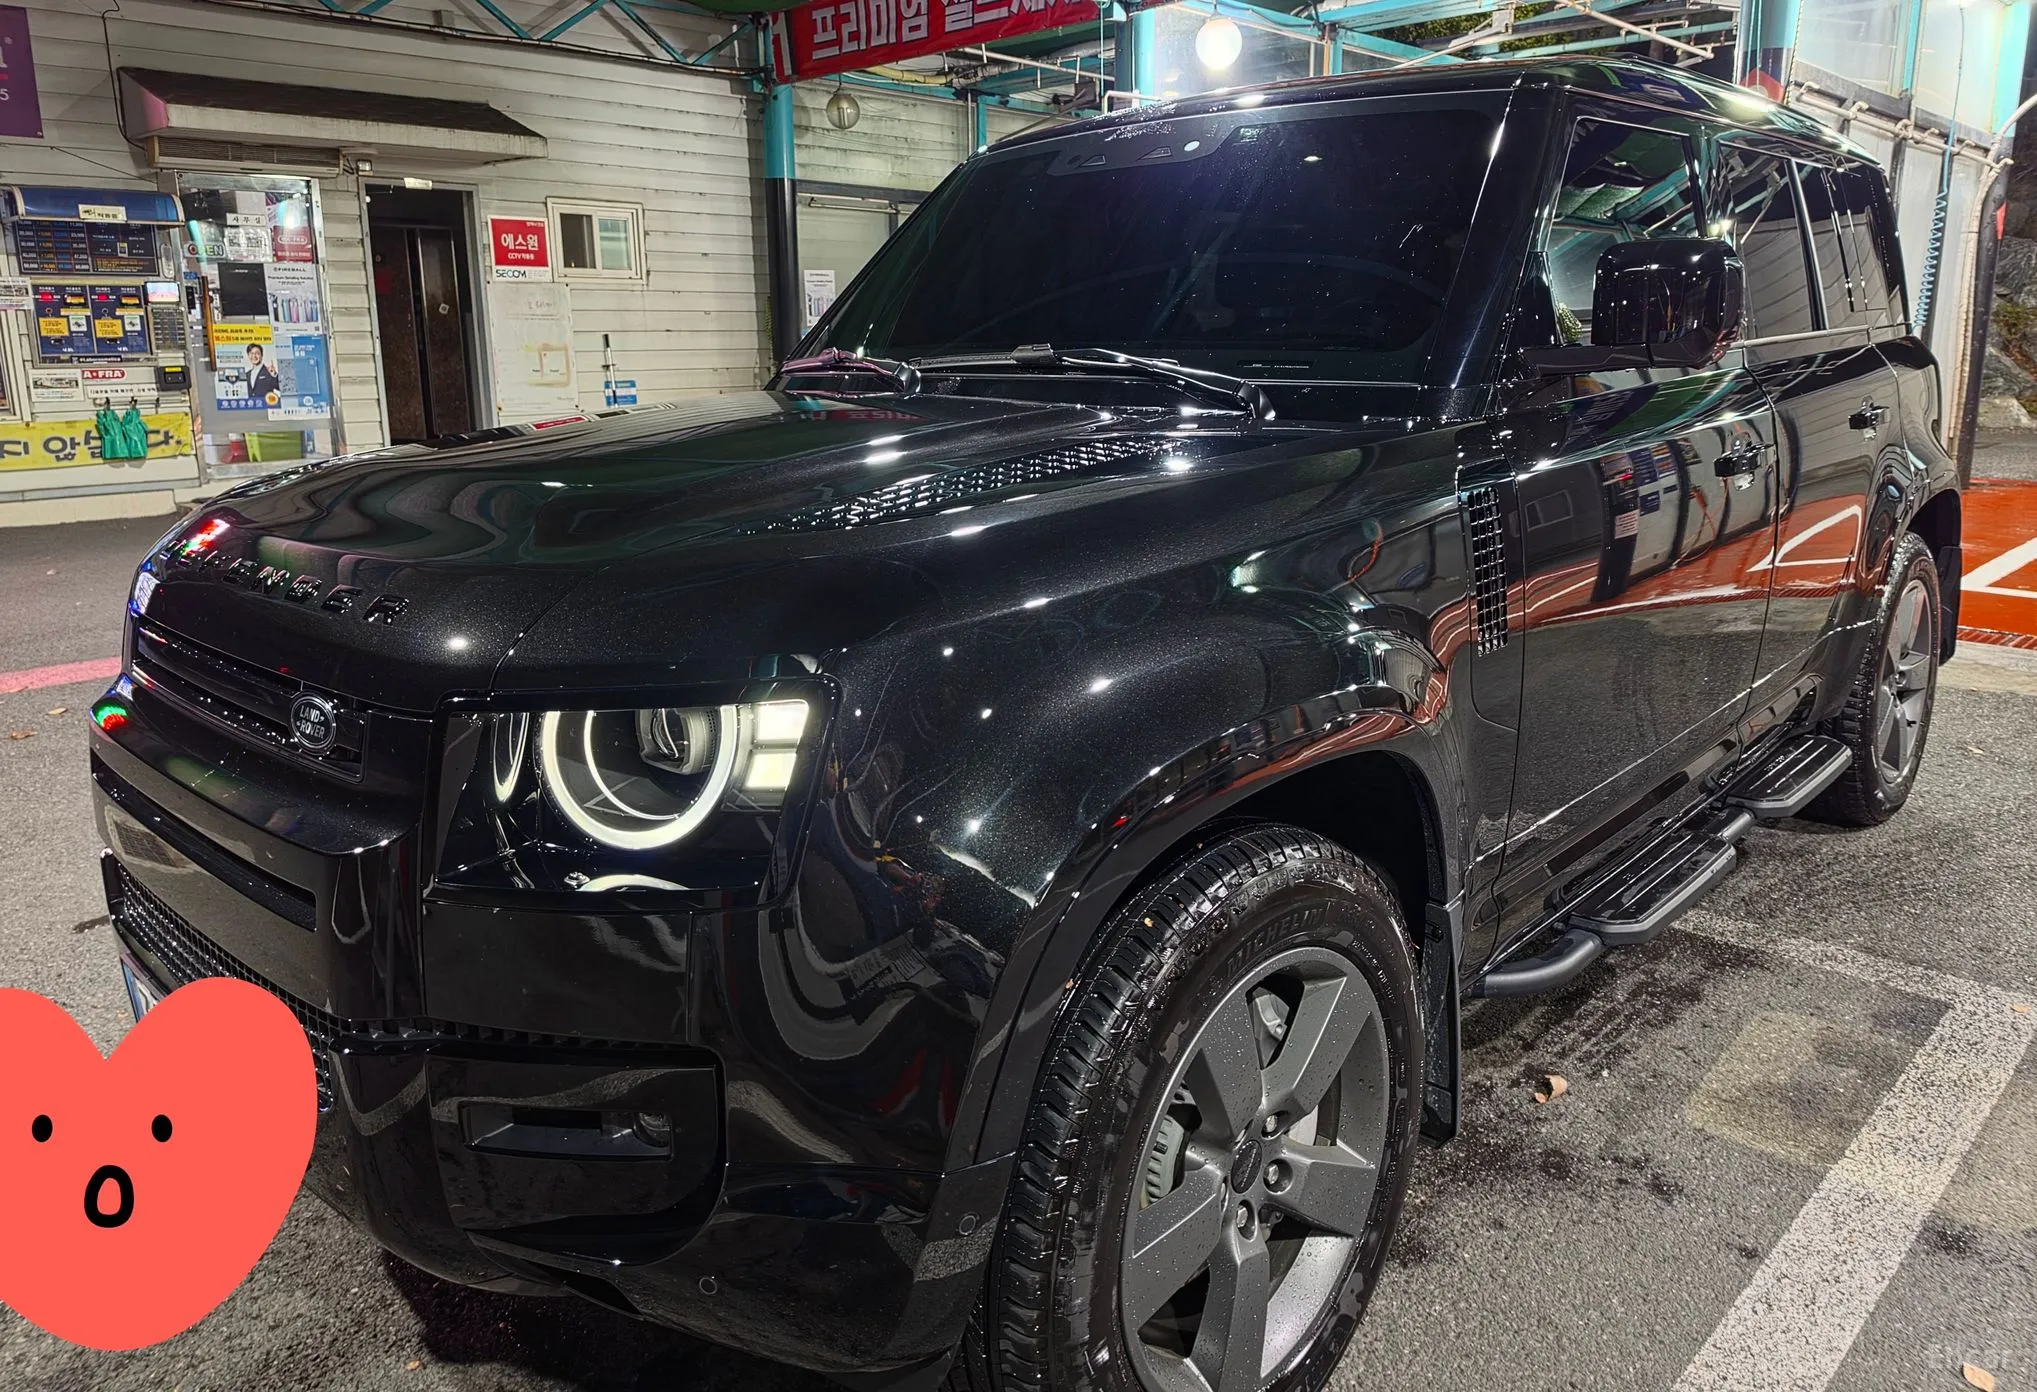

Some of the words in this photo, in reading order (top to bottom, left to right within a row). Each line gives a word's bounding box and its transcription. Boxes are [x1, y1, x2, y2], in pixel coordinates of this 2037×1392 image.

[811, 0, 928, 60] 프리미엄
[188, 243, 224, 256] OEN
[500, 233, 539, 251] 에스원
[495, 269, 527, 279] SECOM
[43, 430, 182, 462] 않다.
[1227, 907, 1323, 977] MICHELIN
